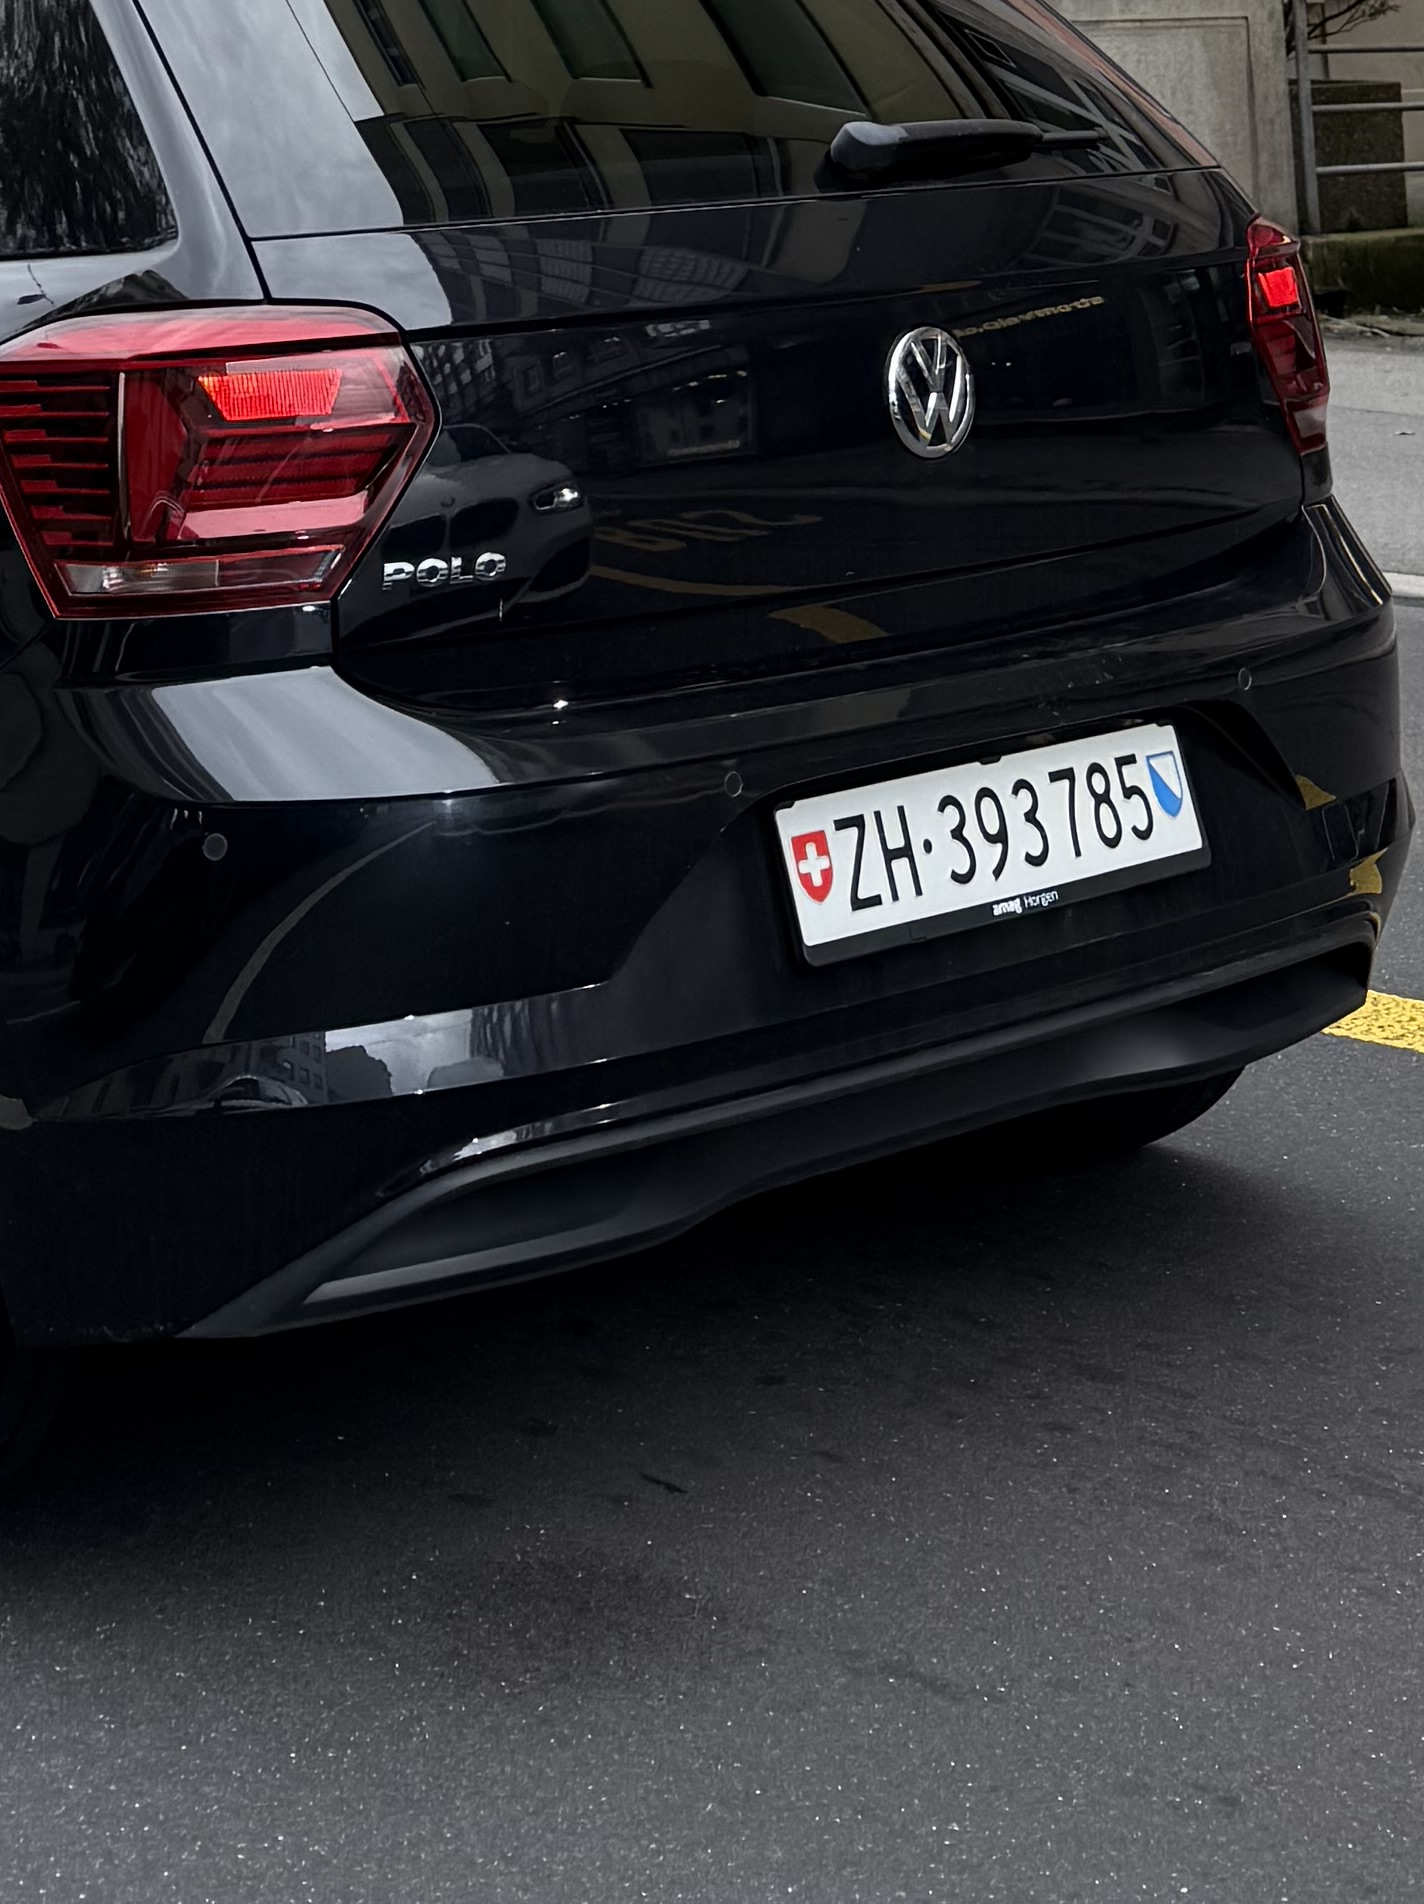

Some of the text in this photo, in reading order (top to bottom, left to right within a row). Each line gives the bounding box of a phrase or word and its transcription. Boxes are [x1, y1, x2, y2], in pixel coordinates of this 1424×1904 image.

[382, 552, 506, 590] POLO
[992, 890, 1059, 916] amag Horgen
